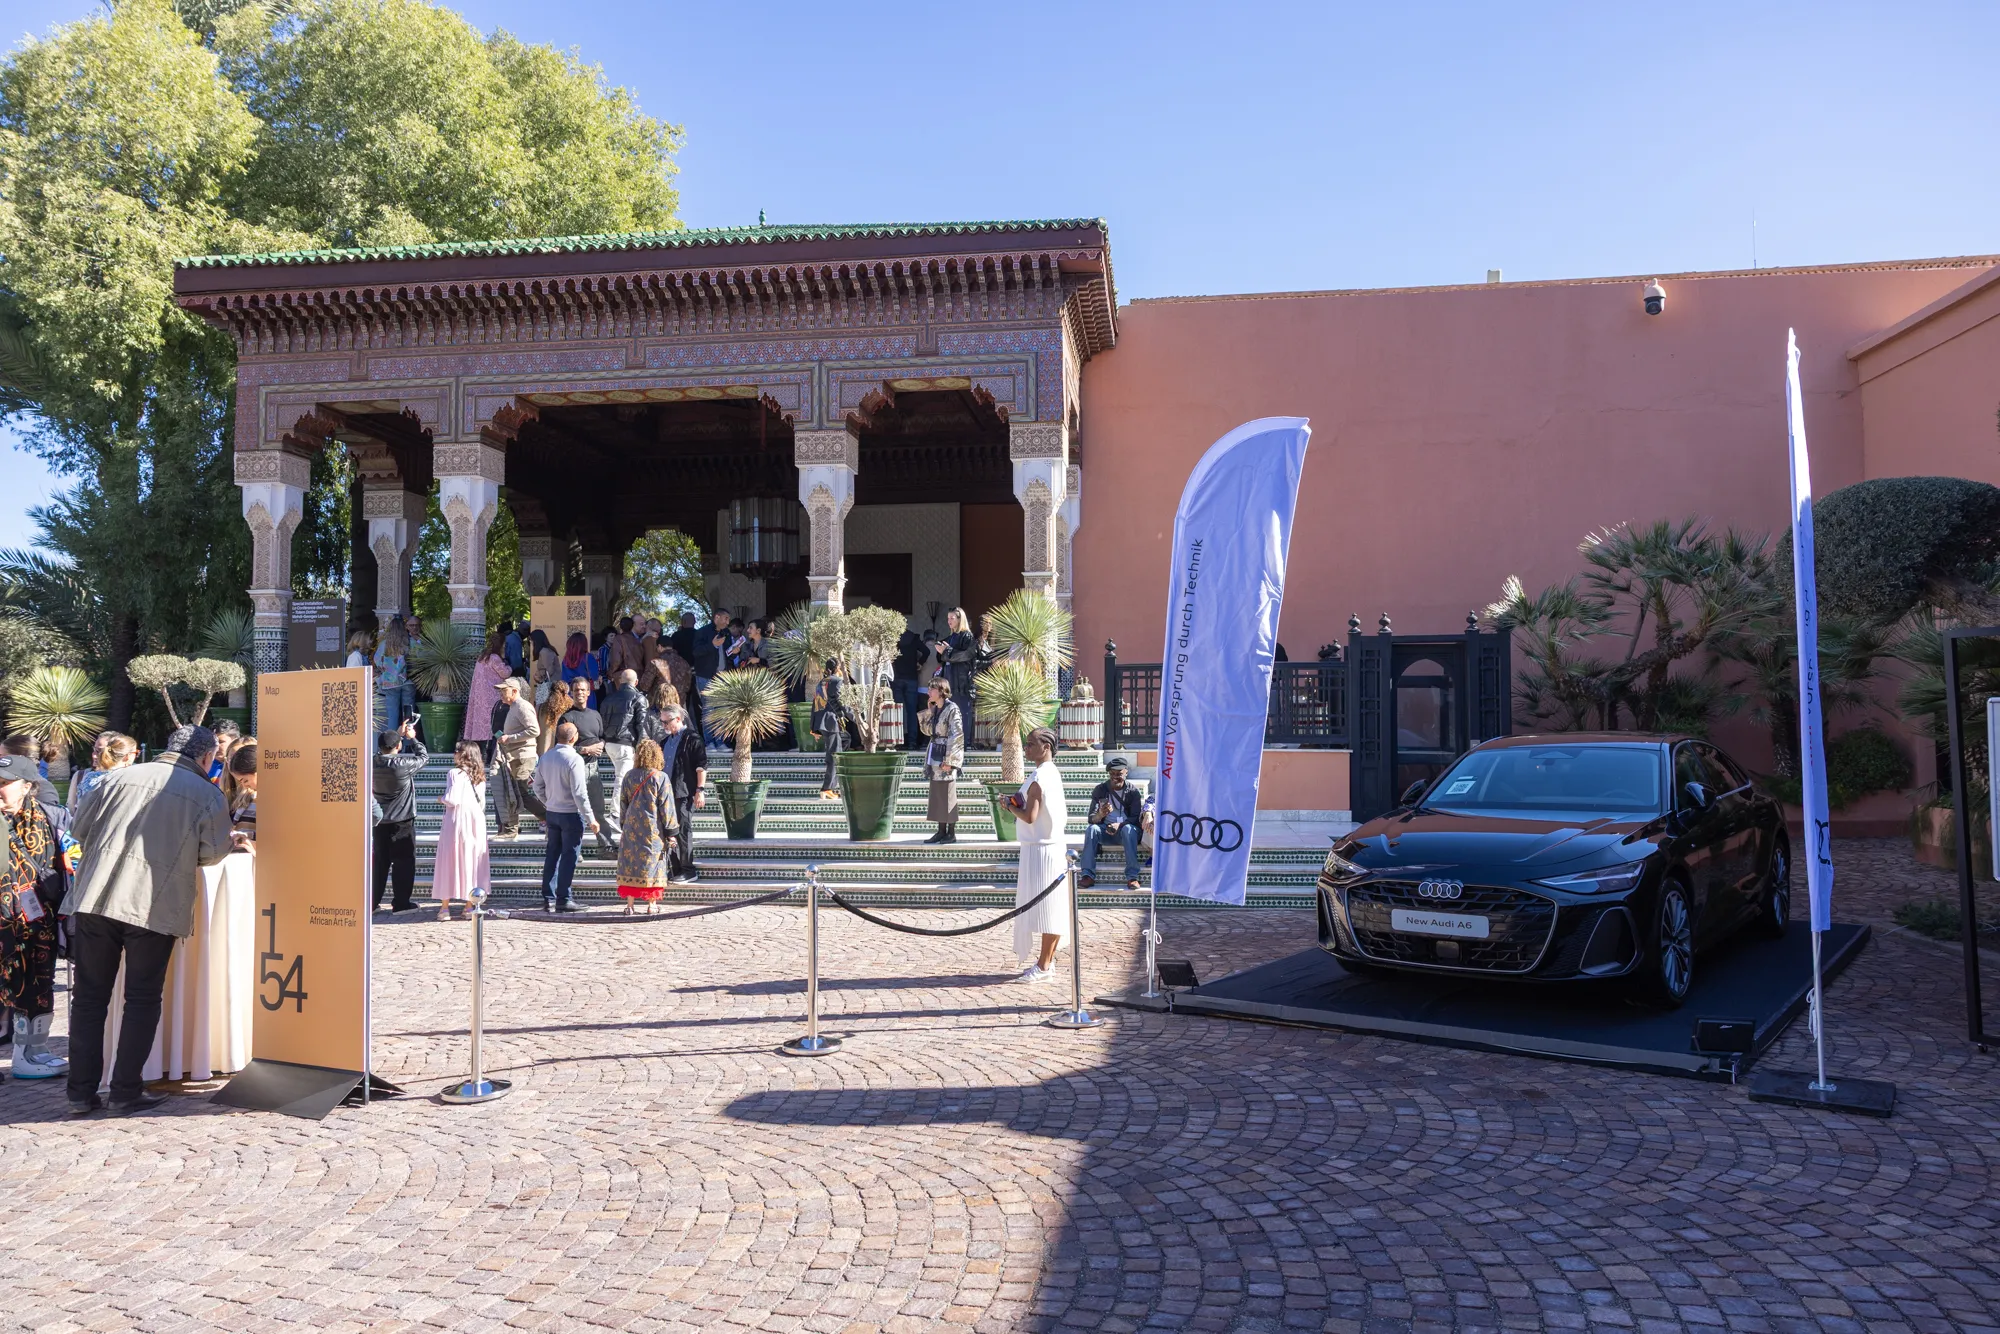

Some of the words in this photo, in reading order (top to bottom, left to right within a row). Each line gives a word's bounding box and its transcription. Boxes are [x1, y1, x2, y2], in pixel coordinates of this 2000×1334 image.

[1183, 538, 1204, 598] Technik
[1177, 603, 1194, 648] durch
[264, 686, 280, 696] Map
[1165, 653, 1189, 736] Vorsprung
[264, 750, 277, 760] Buy
[278, 749, 300, 758] tickets
[264, 760, 279, 769] here
[1161, 741, 1176, 780] Audi
[309, 904, 356, 918] Contemporary
[309, 916, 333, 926] African
[333, 918, 343, 926] Art
[344, 918, 357, 927] Fair
[1406, 916, 1428, 926] New
[1430, 919, 1454, 928] Audi
[1457, 921, 1472, 930] A6
[262, 902, 284, 960] 1
[260, 952, 308, 1013] 54
